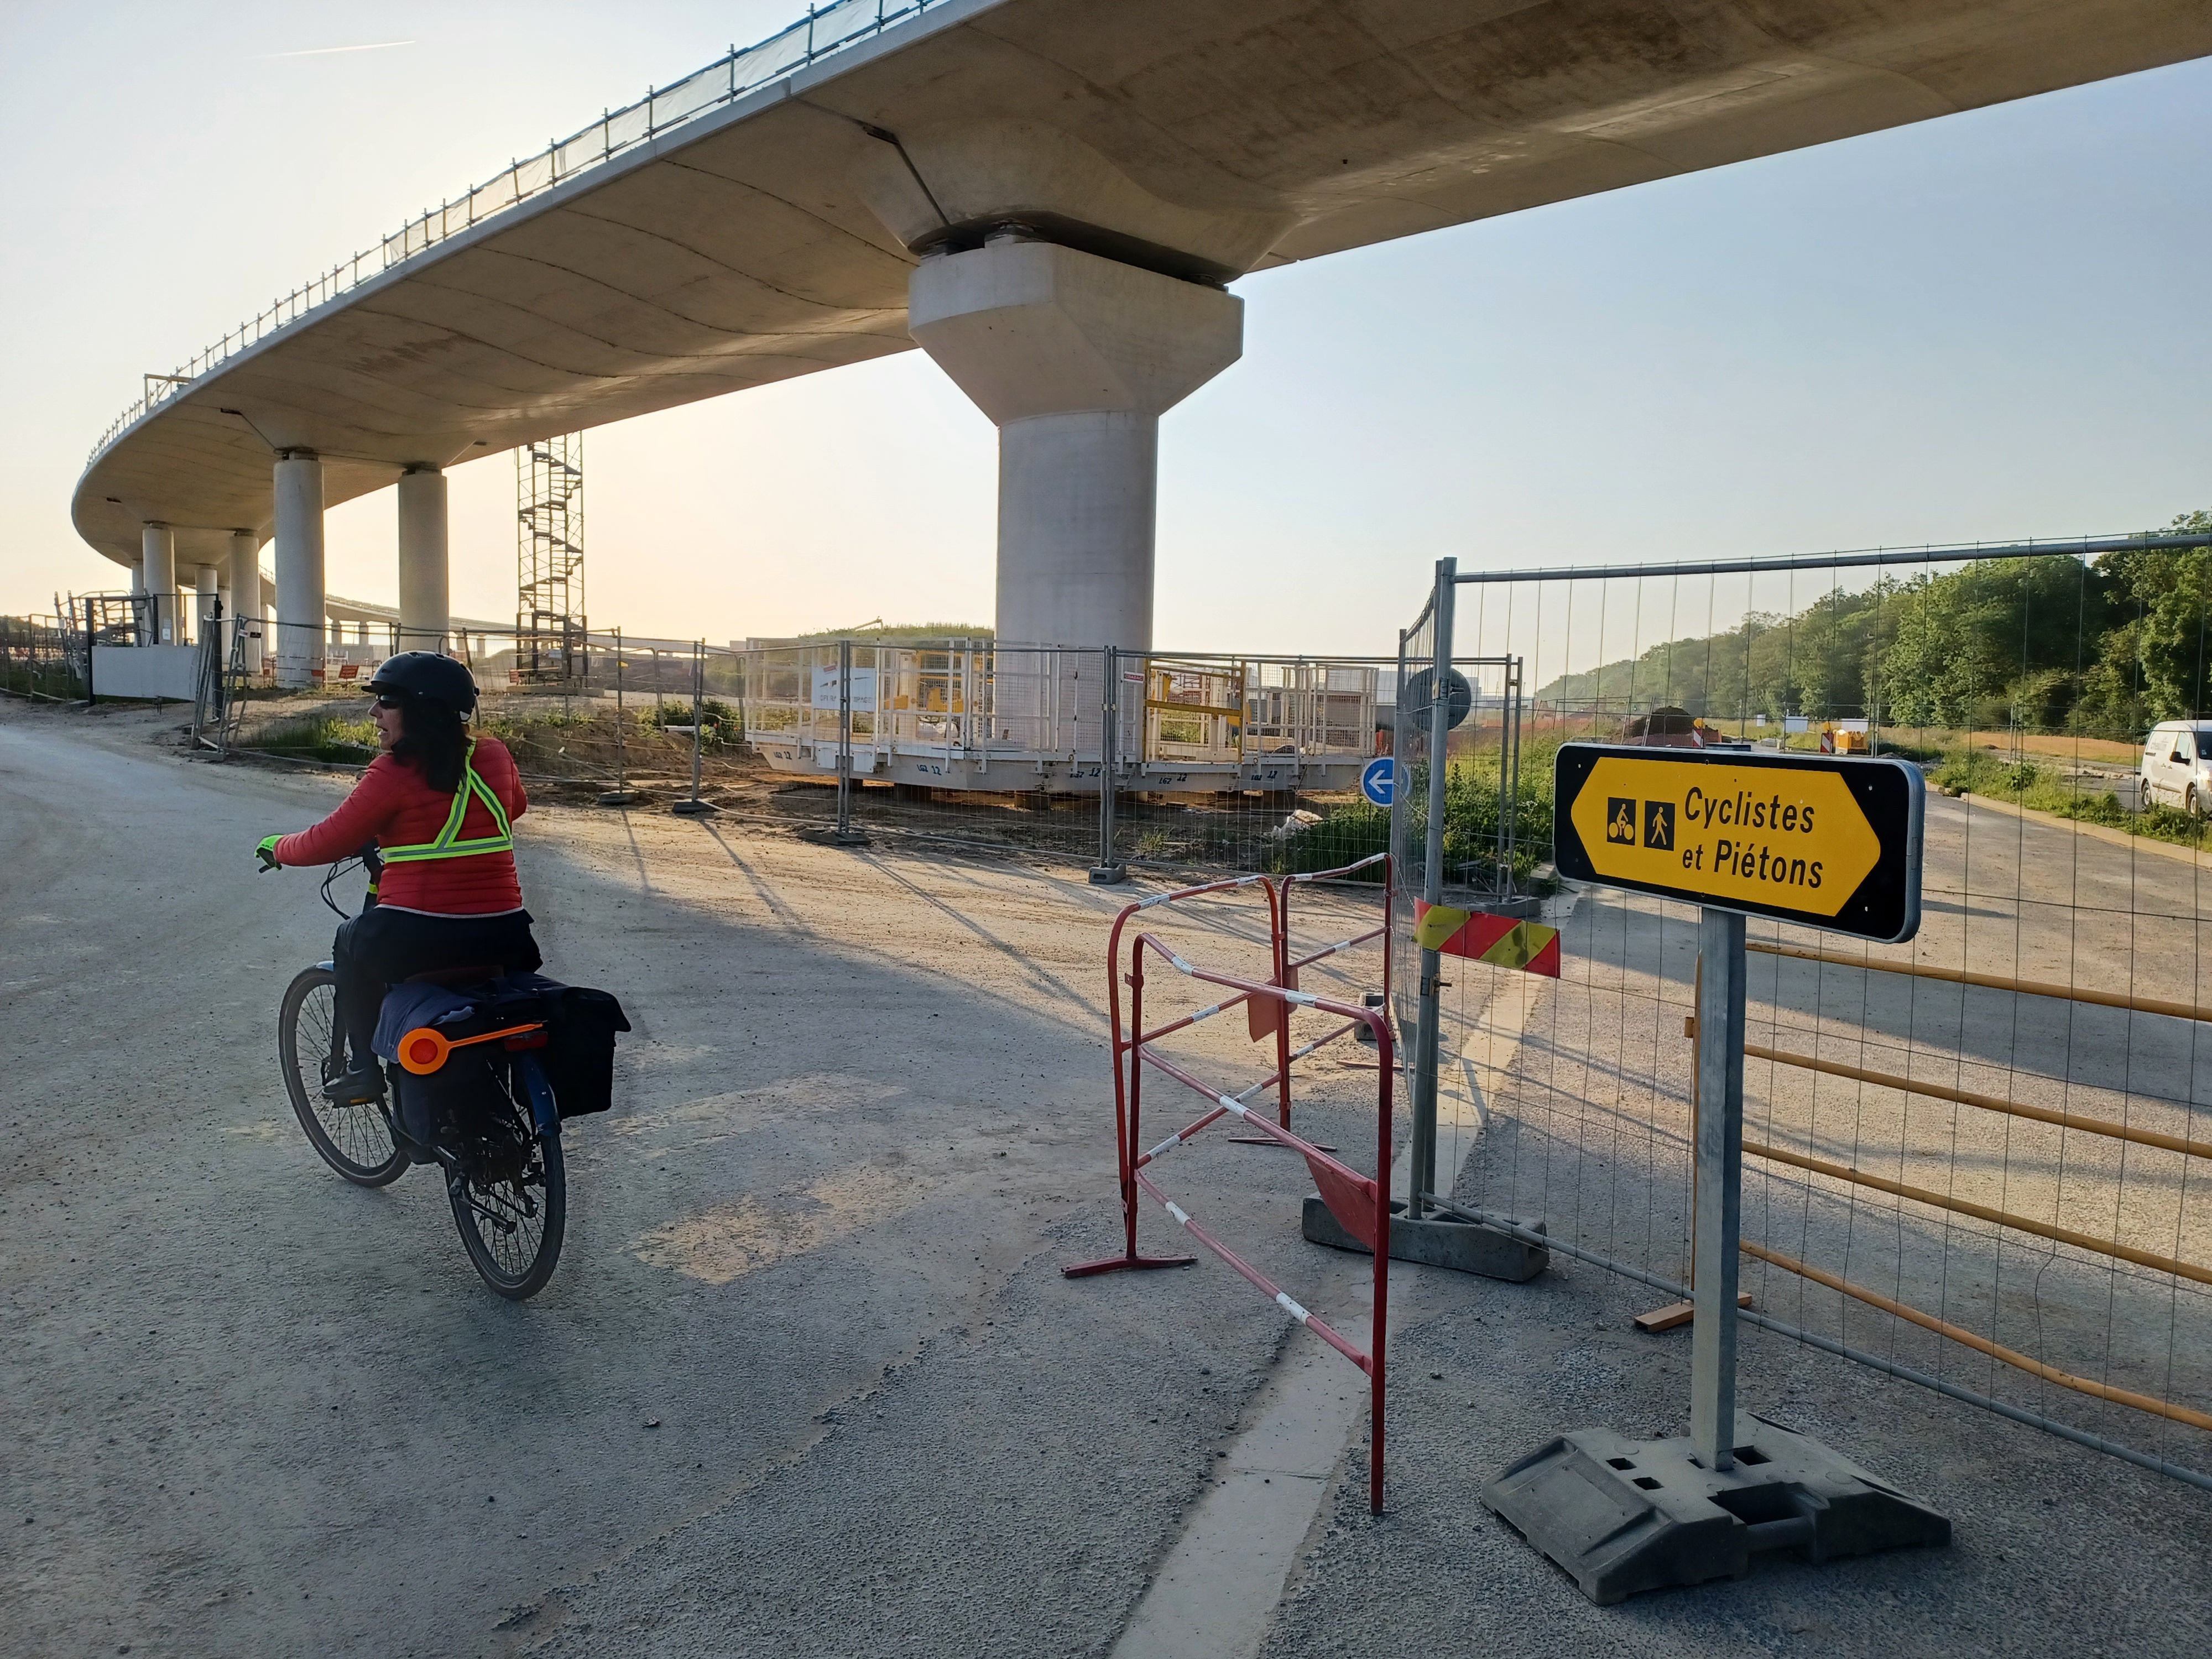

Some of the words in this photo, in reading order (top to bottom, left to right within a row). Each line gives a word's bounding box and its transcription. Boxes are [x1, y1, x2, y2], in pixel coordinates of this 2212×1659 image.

[783, 751, 792, 760] 12
[931, 765, 942, 776] 12
[1089, 768, 1100, 778] 12
[1685, 786, 1814, 834] Cyclistes
[1682, 844, 1704, 871] et
[1714, 839, 1824, 889] Piétons
